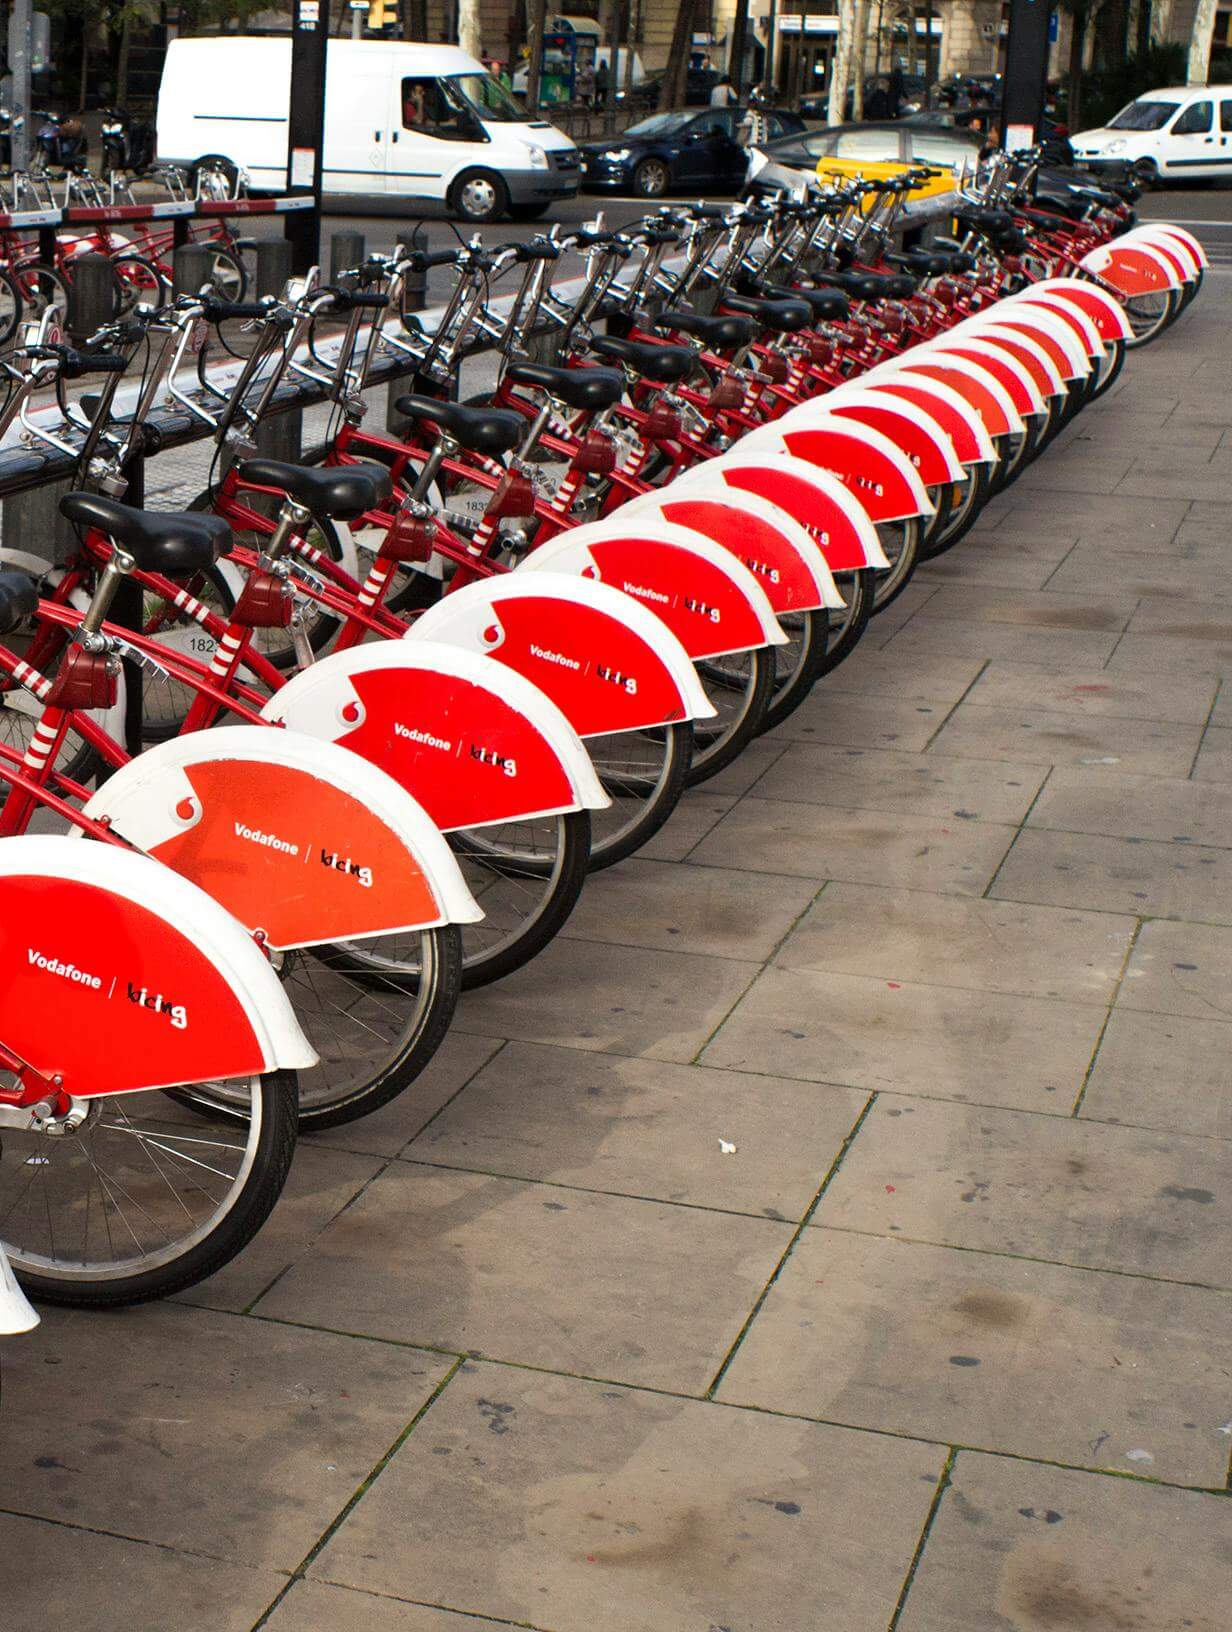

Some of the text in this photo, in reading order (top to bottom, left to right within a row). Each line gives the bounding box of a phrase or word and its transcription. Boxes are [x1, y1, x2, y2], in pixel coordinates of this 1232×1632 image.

[466, 501, 488, 512] 183
[624, 581, 669, 603] Vodafone
[190, 638, 216, 653] 182
[530, 644, 580, 670] Vodafone
[394, 722, 517, 777] Vodafone bicing
[234, 822, 373, 887] Vodafone bicing
[27, 949, 187, 1029] Vodafone bicing
